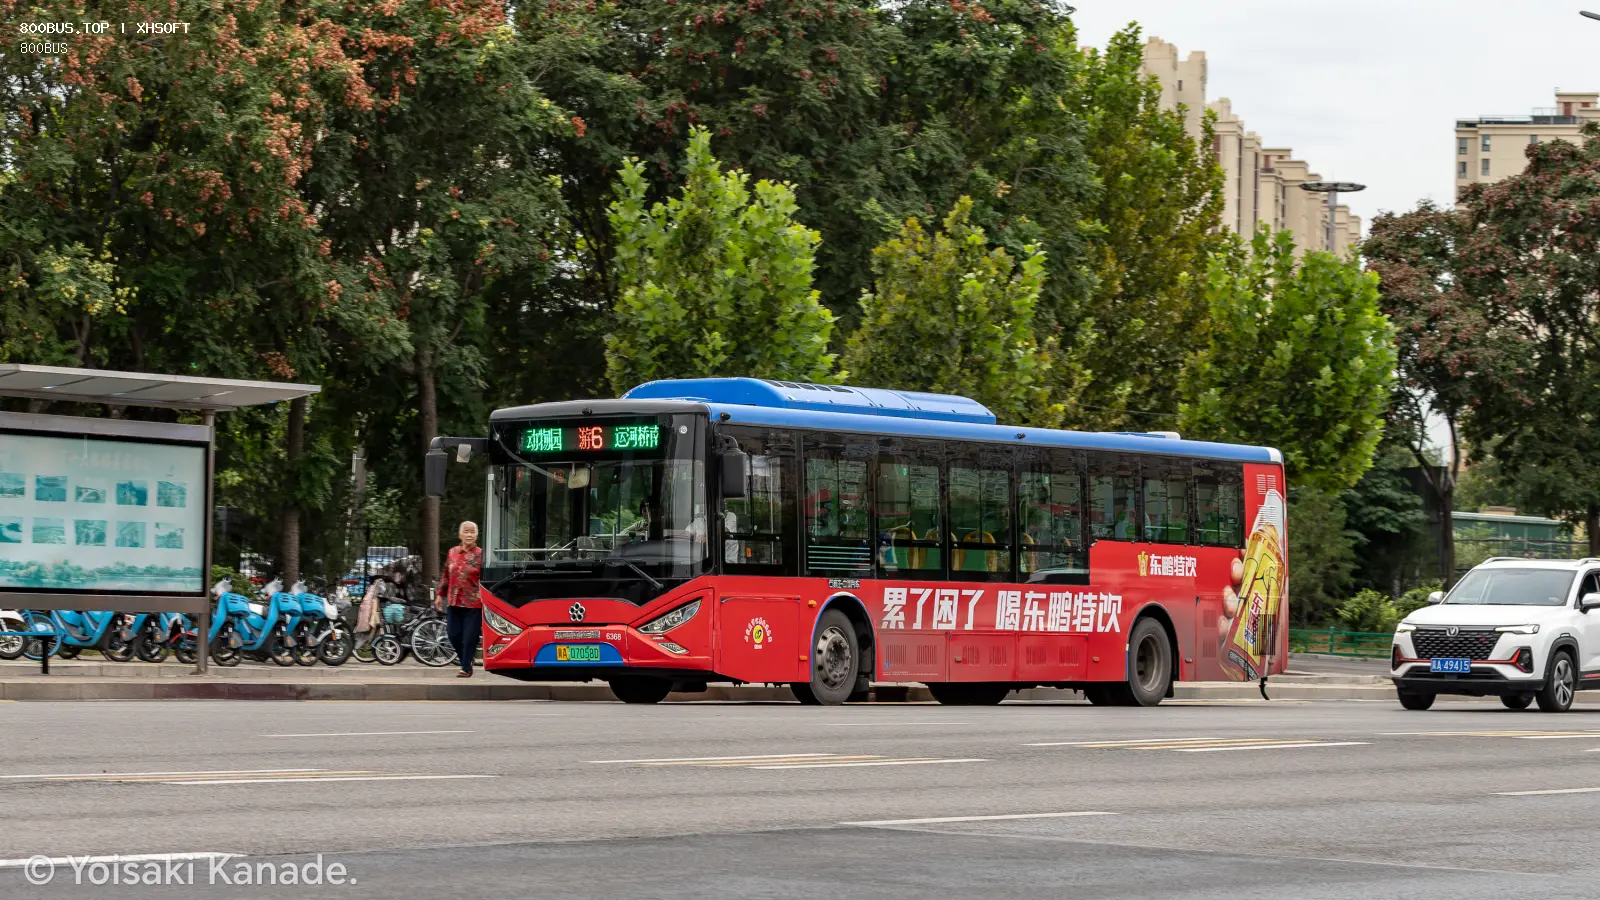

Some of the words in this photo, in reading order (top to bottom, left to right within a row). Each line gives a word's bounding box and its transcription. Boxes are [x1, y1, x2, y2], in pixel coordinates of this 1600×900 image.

[526, 428, 562, 451] 动物园
[579, 427, 603, 450] 游6
[615, 425, 659, 448] 运河桥南
[1150, 553, 1197, 577] 东鹏特饮
[881, 587, 985, 631] 累了困了
[995, 590, 1123, 633] 喝东鹏特饮
[606, 633, 622, 641] 6368
